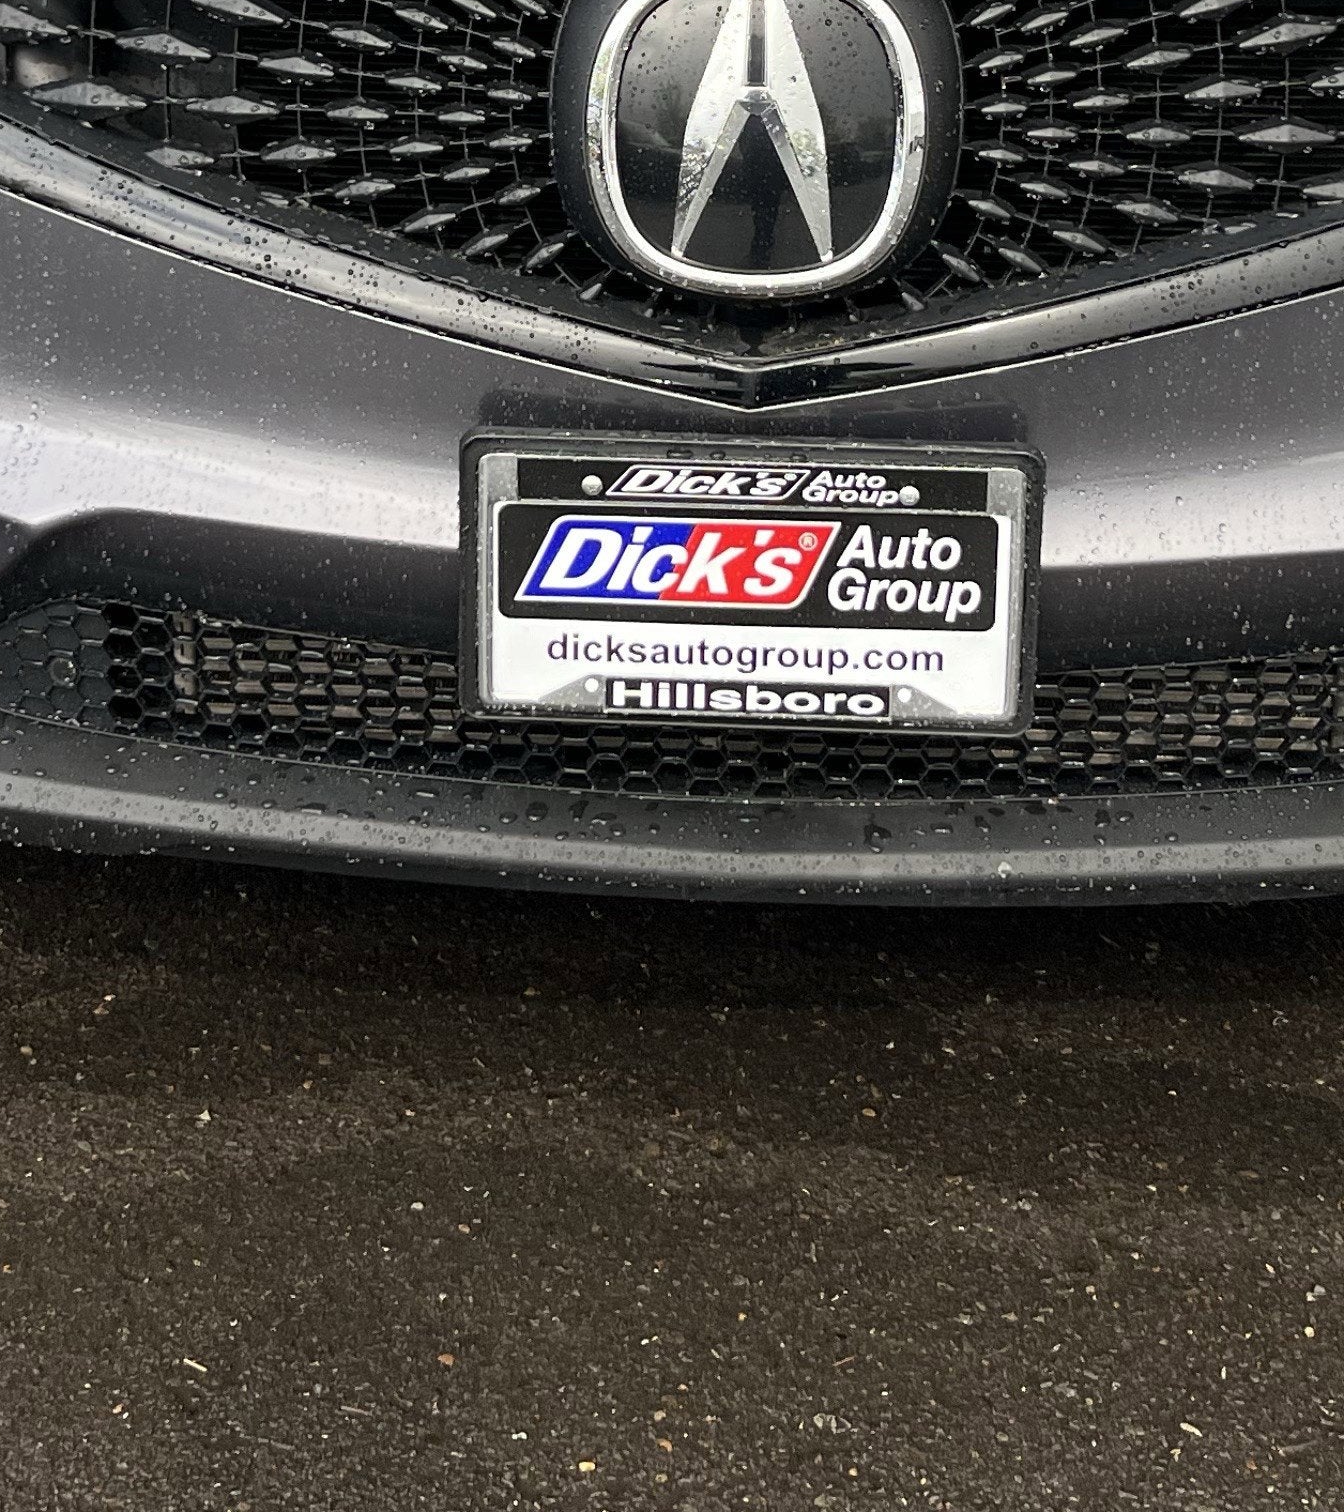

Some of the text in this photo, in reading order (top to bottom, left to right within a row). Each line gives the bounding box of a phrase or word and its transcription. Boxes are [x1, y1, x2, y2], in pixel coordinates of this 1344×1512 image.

[802, 486, 899, 507] Group
[809, 470, 887, 488] Auto
[837, 525, 962, 571] Auto
[827, 568, 982, 623] Group
[546, 634, 944, 675] dicksautogroup.com
[612, 679, 885, 716] Hillsboro
